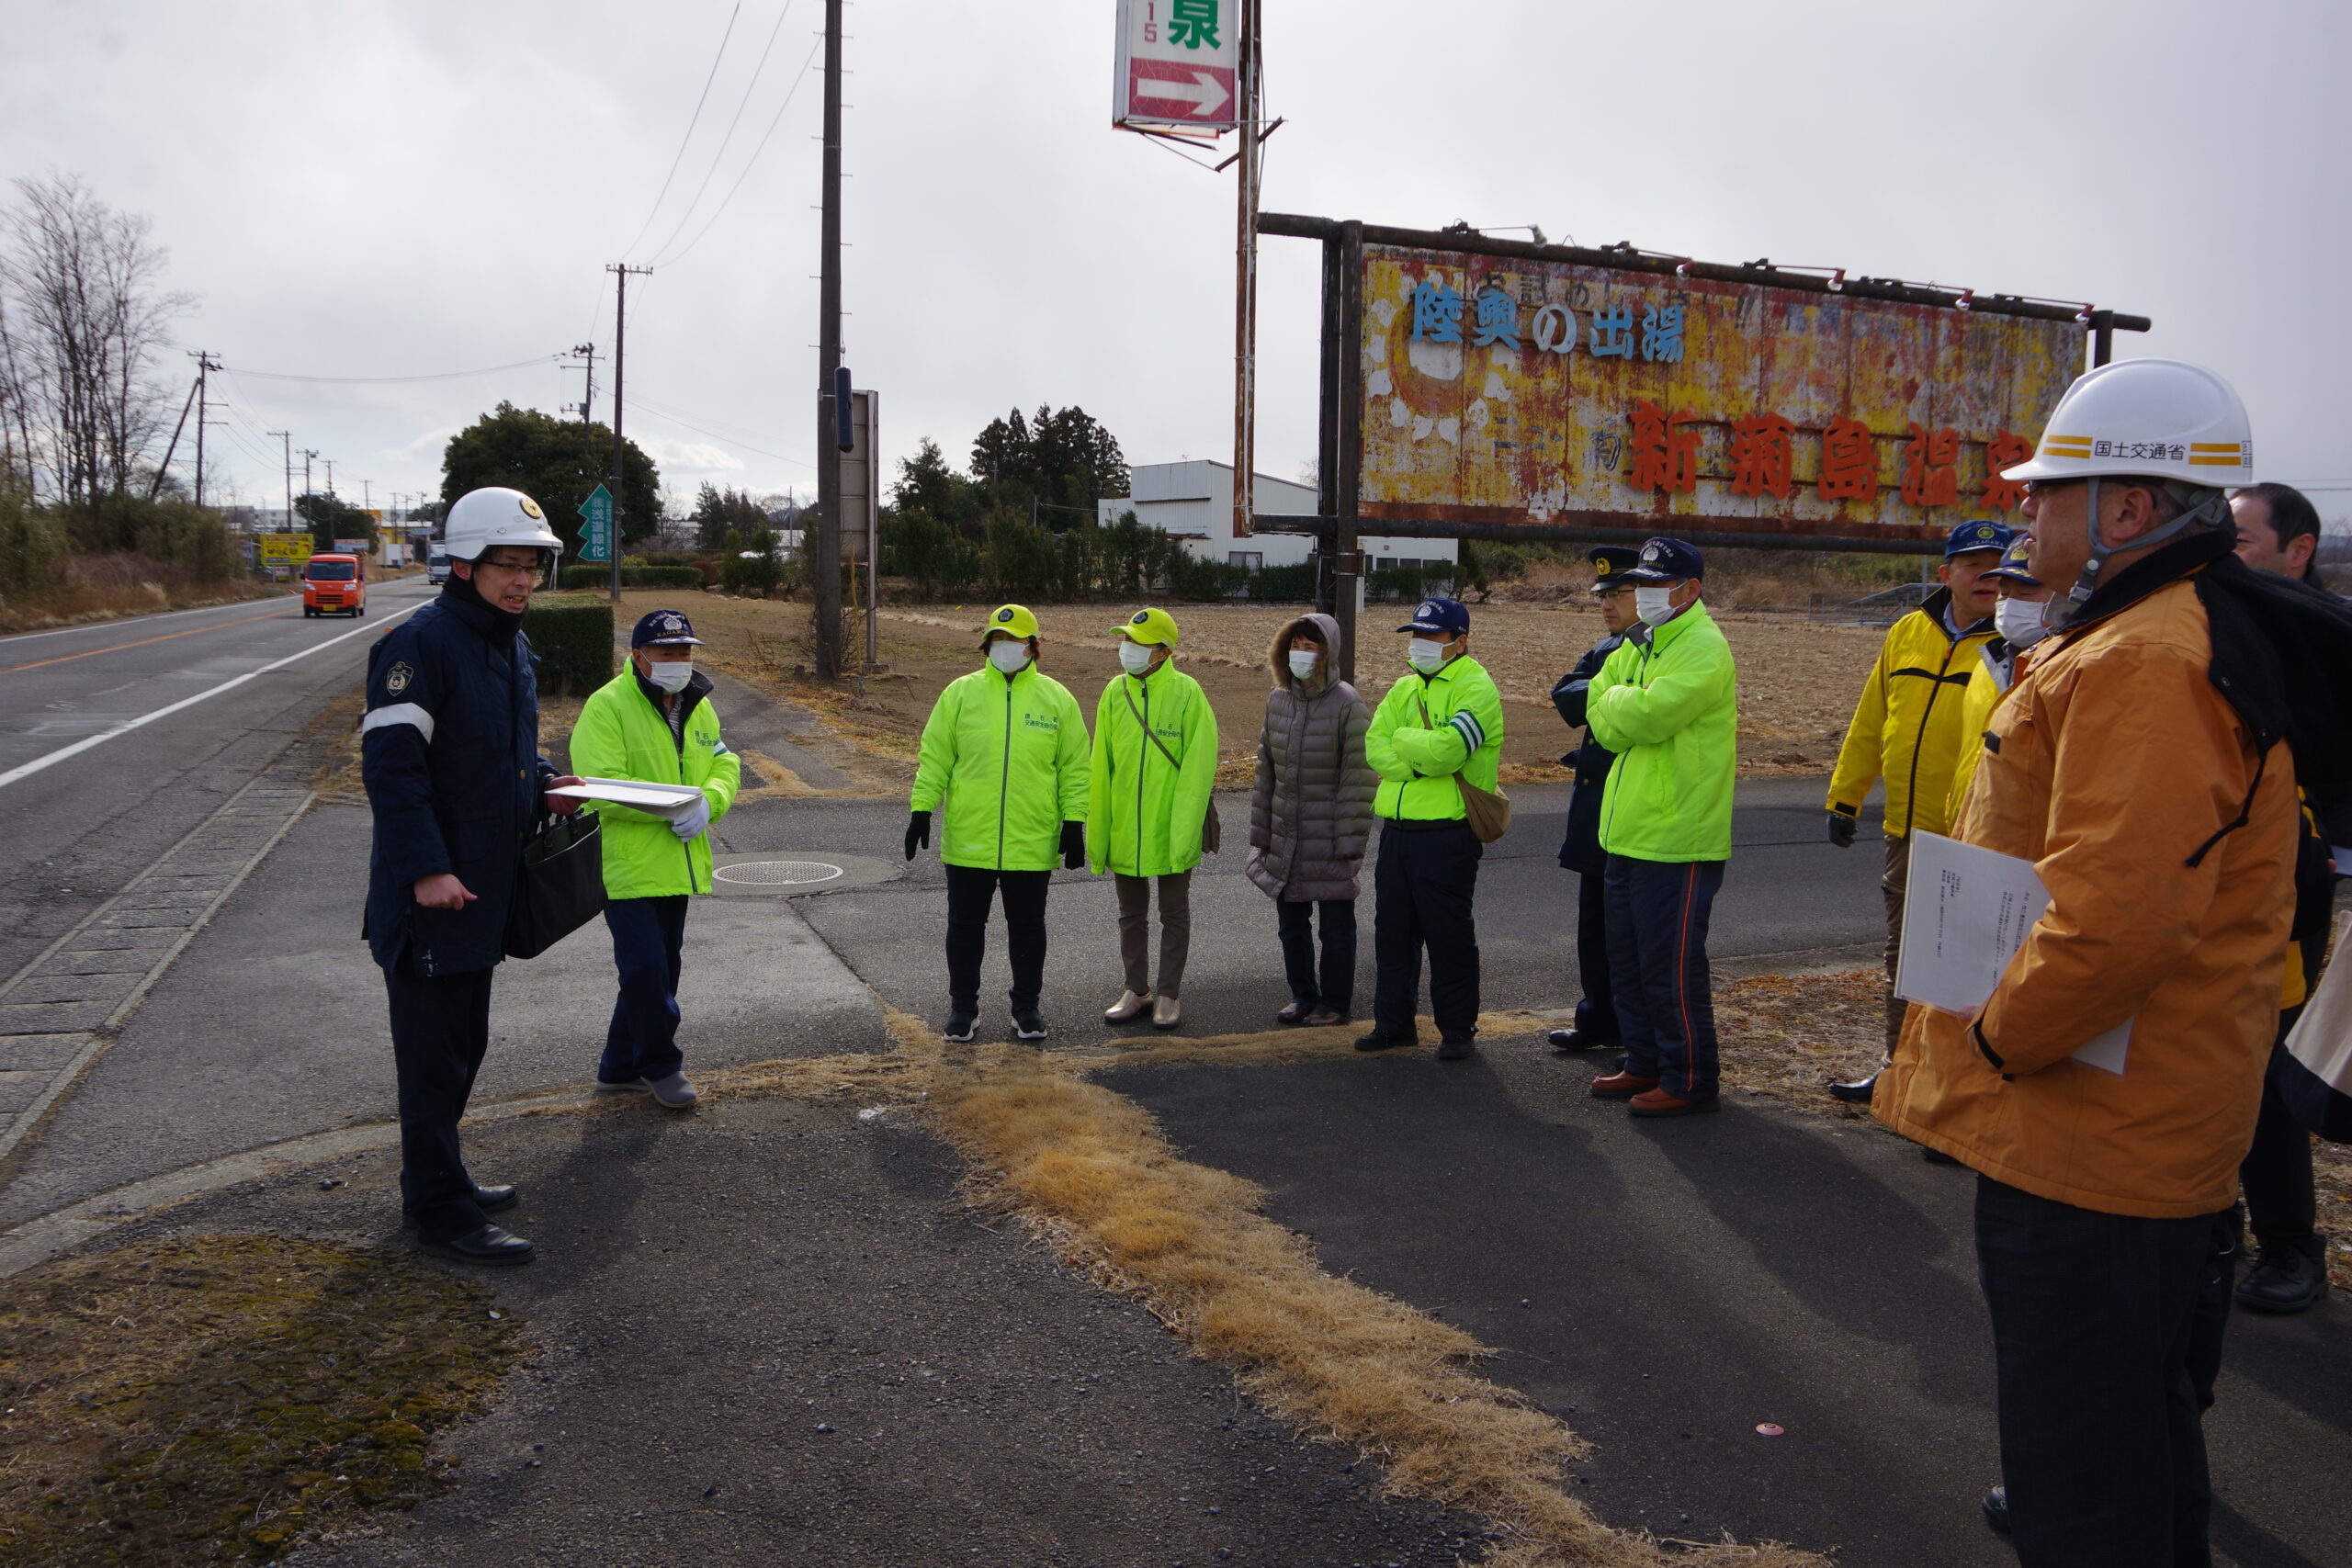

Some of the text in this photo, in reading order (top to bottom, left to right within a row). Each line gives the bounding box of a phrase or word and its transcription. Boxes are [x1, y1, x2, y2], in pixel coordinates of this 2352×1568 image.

[1167, 0, 1222, 51] 泉
[1411, 280, 1685, 364] 陸奥の出湯
[2094, 440, 2187, 461] 国土交通省
